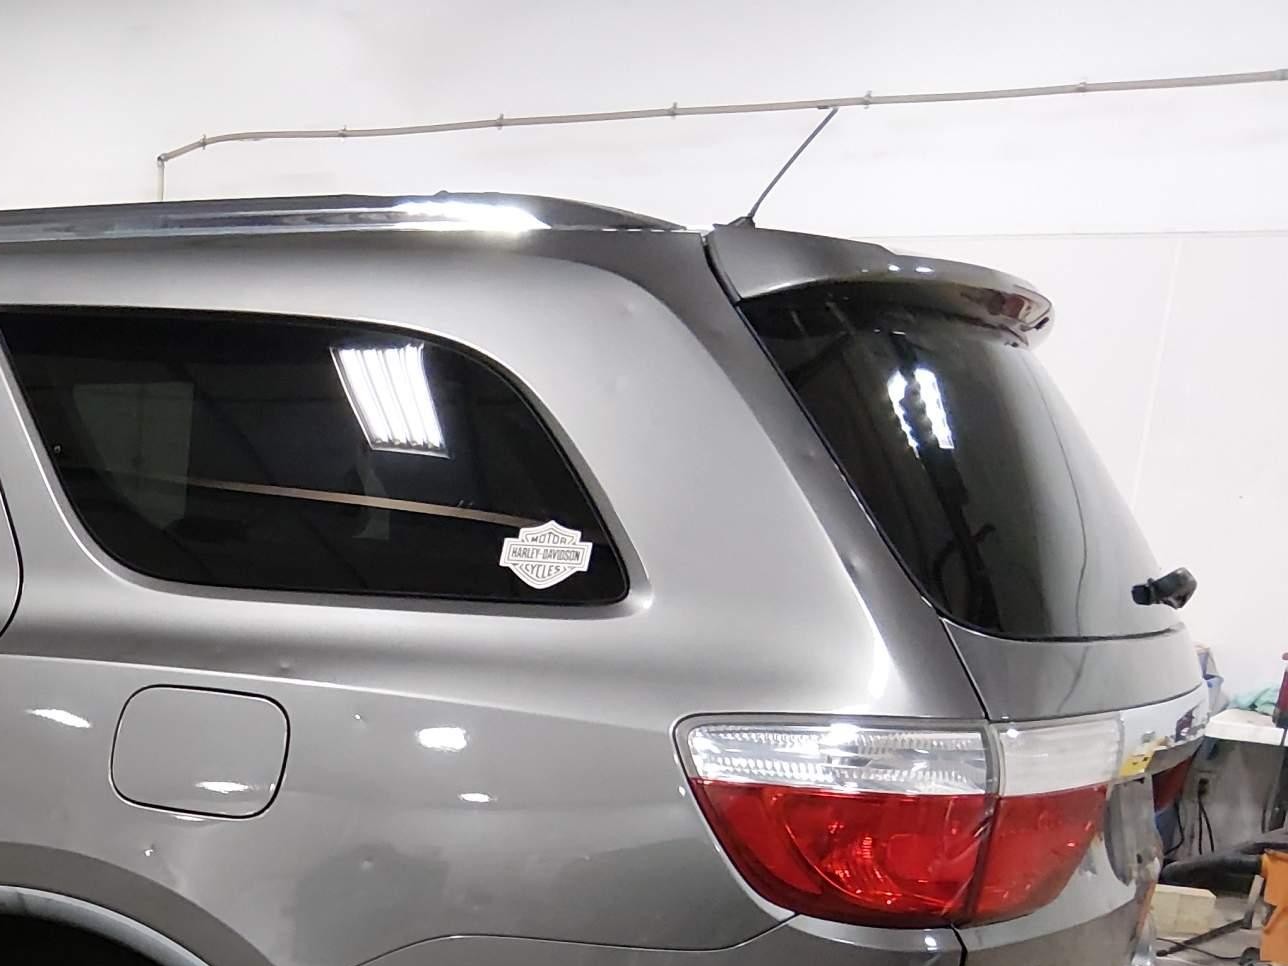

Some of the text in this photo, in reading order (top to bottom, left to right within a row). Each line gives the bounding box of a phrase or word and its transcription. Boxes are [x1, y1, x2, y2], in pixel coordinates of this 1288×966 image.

[530, 531, 567, 545] MOTOR
[511, 547, 581, 561] HARLEY-DAVIDSON
[524, 563, 561, 579] CYCLES
